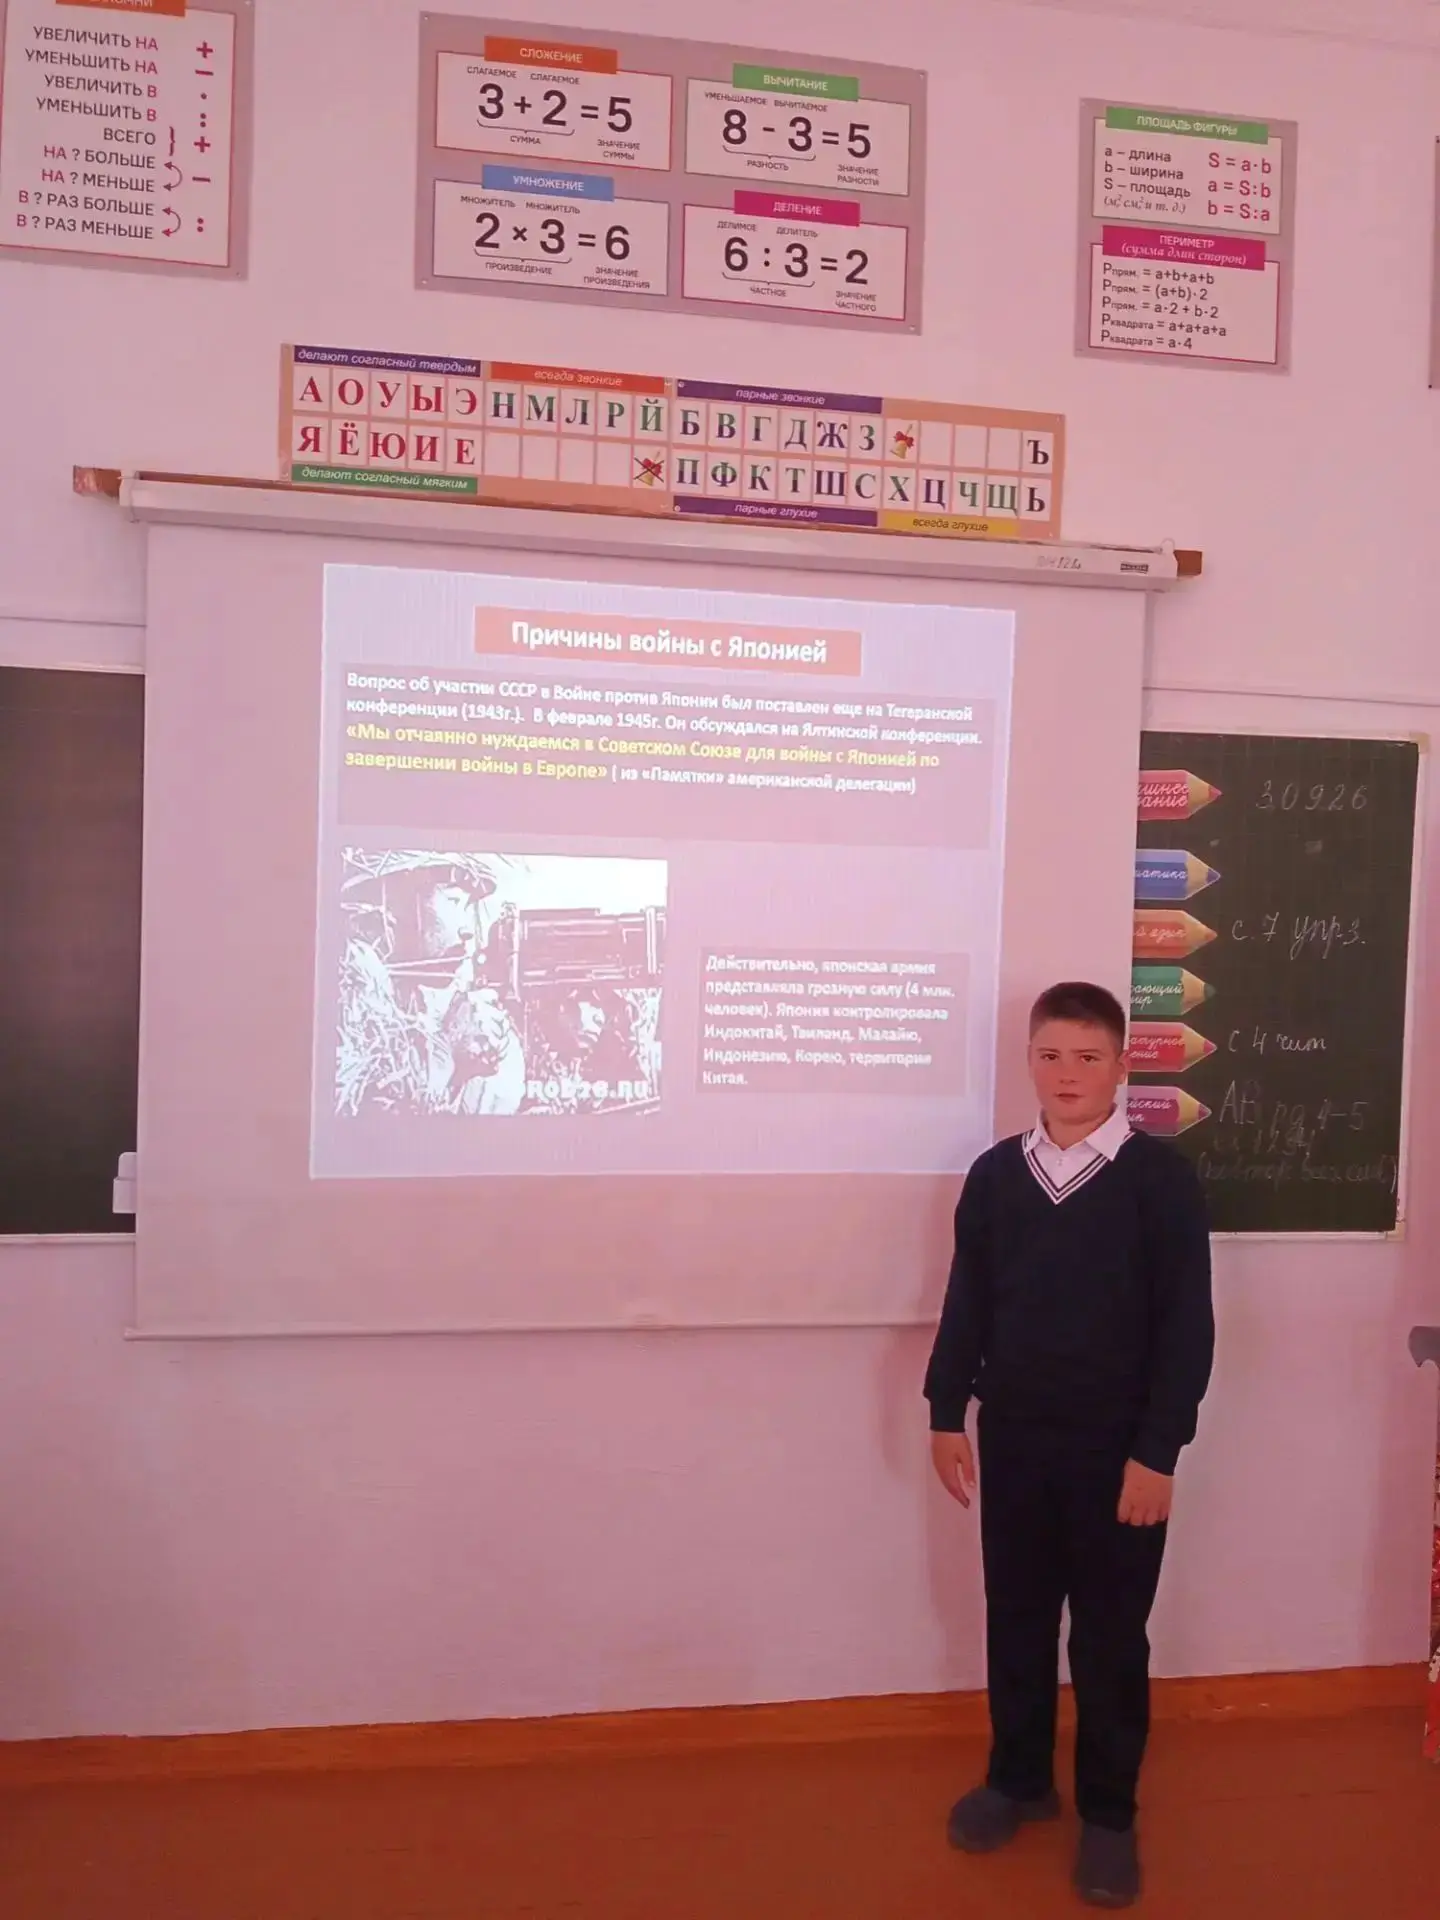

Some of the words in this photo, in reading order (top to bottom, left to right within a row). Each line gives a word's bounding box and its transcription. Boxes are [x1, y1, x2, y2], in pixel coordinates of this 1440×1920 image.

[33, 26, 131, 48] УВЕЛИЧИТЬ
[135, 37, 158, 50] НА
[25, 48, 130, 71] УМЕНЬШИТЬ
[135, 61, 158, 74] НА
[520, 48, 584, 64] СЛОЖЕНИЕ
[467, 66, 517, 78] СЛАГАЕМОЕ
[530, 73, 580, 85] СЛАГАЕМОЕ
[764, 74, 828, 91] ВЫЧИТАНИЕ
[44, 74, 142, 96] УВЕЛИЧИТЬ
[147, 85, 157, 98] В
[36, 97, 142, 120] УМЕНЬШИТЬ
[147, 109, 156, 121] В
[704, 91, 767, 106] УМЕНЬШАЕМОЕ
[774, 100, 828, 112] ВЫЧИТАЕМОЕ
[1137, 115, 1190, 130] ПЛОЩАДЬ
[1193, 122, 1238, 136] ФИГУРЫ
[103, 128, 156, 146] ВСЕГО
[510, 136, 541, 145] СУММА
[598, 139, 640, 150] ЗНАЧЕНИЕ
[44, 146, 66, 160] НА
[73, 149, 80, 161] ?
[85, 150, 156, 169] БОЛЬШЕ
[603, 151, 635, 160] СУММЫ
[1129, 149, 1172, 163] длина
[747, 160, 790, 171] РАЗНОСТЬ
[838, 164, 878, 175] ЗНАЧЕНИЕ
[1105, 161, 1113, 173] b
[1130, 167, 1184, 180] ширина
[42, 170, 64, 183] НА
[71, 172, 78, 184] ?
[83, 174, 155, 192] МЕНЬШЕ
[513, 175, 584, 192] УМНОЖЕНИЕ
[837, 175, 880, 186] РАЗНОСТИ
[1104, 178, 1114, 190] S
[1130, 184, 1190, 199] площадь
[18, 190, 28, 203] В
[34, 193, 42, 206] ?
[47, 194, 79, 208] РАЗ
[84, 197, 154, 216] БОЛЬШЕ
[460, 196, 516, 208] МНОЖИТЕЛЬ
[526, 202, 580, 214] МНОЖИТЕЛЬ
[773, 202, 822, 216] ДЕЛЕНИЕ
[16, 214, 26, 227] В
[32, 216, 40, 228] ?
[44, 217, 76, 232] РАЗ
[82, 220, 154, 240] МЕНЬШЕ
[717, 220, 758, 232] ДЕЛИМОЕ
[776, 226, 818, 238] ДЕЛИТЕЛЬ
[1160, 235, 1216, 250] ПЕРИМЕТР
[1122, 242, 1164, 258] (сумма
[1168, 246, 1195, 260] длин
[1198, 252, 1247, 266] сторон)
[486, 262, 552, 275] ПРОИЗВЕДЕНИЕ
[596, 266, 639, 278] ЗНАЧЕНИЕ
[584, 276, 650, 290] ПРОИЗВЕДЕНИЯ
[750, 287, 786, 298] ЧАСТНОЕ
[836, 290, 876, 302] ЗНАЧЕНИЕ
[835, 301, 876, 312] ЧАСТНОГО
[298, 349, 348, 363] делают
[352, 353, 416, 368] согласный
[419, 360, 476, 374] твердым
[534, 370, 574, 382] всегда
[576, 376, 622, 386] звонкие
[736, 388, 778, 401] парные
[782, 394, 826, 406] звонкие
[299, 376, 323, 402] А
[338, 378, 364, 406] О
[377, 381, 402, 408] У
[412, 384, 444, 412] Ы
[455, 388, 477, 416] Э
[492, 391, 516, 420] Н
[526, 394, 556, 422] М
[566, 398, 589, 426] Л
[606, 402, 624, 428] Р
[640, 398, 664, 432] Й
[680, 409, 700, 436] Б
[716, 412, 736, 438] В
[752, 415, 772, 442] Г
[784, 419, 808, 450] Д
[817, 421, 848, 448] Ж
[858, 424, 875, 451] З
[1028, 439, 1050, 465] Ъ
[302, 466, 351, 480] делают
[355, 472, 420, 486] согласный
[422, 477, 468, 490] мягким
[734, 503, 777, 516] парные
[780, 508, 818, 519] глухие
[912, 518, 949, 529] всегда
[952, 522, 988, 532] глухие
[512, 620, 622, 651] Причины
[629, 630, 702, 656] войны
[710, 642, 722, 658] с
[728, 636, 828, 664] Японией
[347, 672, 406, 693] Вопрос
[408, 676, 430, 690] об
[432, 680, 494, 696] участии
[499, 682, 537, 697] СССР
[540, 687, 549, 698] в
[554, 684, 602, 702] Войне
[604, 690, 658, 708] против
[662, 692, 718, 708] Японии
[722, 694, 751, 710] был
[756, 698, 828, 714] поставлен
[833, 703, 862, 718] еще
[866, 706, 882, 717] на
[887, 703, 972, 722] Тегеранской
[346, 698, 458, 719] конференции
[534, 708, 544, 722] В
[547, 707, 612, 728] феврале
[616, 712, 662, 730] 1945г.
[665, 716, 686, 730] Он
[690, 716, 778, 736] обсуждался
[782, 724, 798, 736] на
[802, 723, 878, 740] Ялтинской
[880, 728, 982, 746] конференции.
[346, 723, 390, 740] «Мы
[395, 728, 477, 745] отчаянно
[482, 733, 580, 752] нуждаемся
[584, 738, 594, 751] в
[598, 736, 686, 756] Советском
[690, 742, 742, 758] Союзе
[745, 746, 775, 763] для
[780, 745, 832, 762] войны
[836, 752, 844, 762] с
[848, 750, 916, 767] Японией
[920, 755, 940, 767] по
[345, 752, 456, 770] завершении
[461, 756, 517, 776] войны
[522, 763, 533, 776] в
[538, 759, 608, 780] Европе»
[620, 768, 638, 781] из
[642, 766, 724, 784] «Памятки»
[728, 774, 832, 790] американской
[836, 777, 916, 795] делегации)
